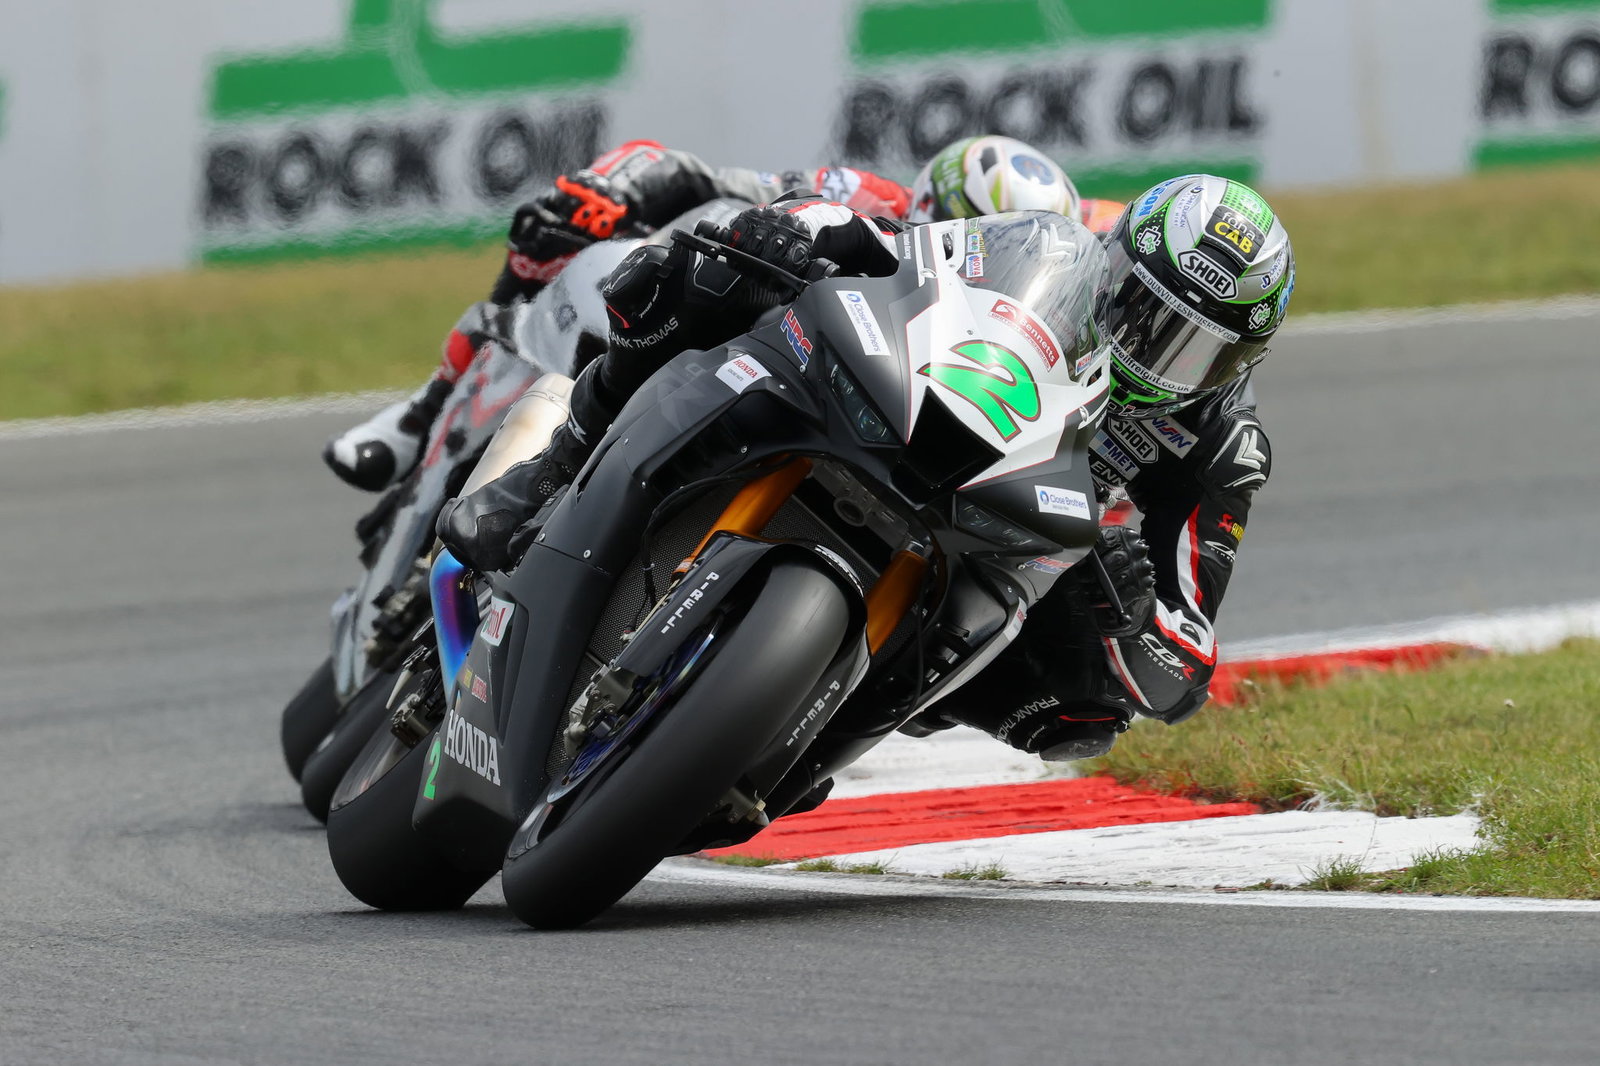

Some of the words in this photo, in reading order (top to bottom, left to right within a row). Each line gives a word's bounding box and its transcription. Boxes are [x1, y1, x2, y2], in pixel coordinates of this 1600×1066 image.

[1482, 34, 1600, 117] RO
[842, 62, 1093, 165] ROCK
[1117, 54, 1259, 147] OIL
[204, 118, 452, 230] ROCK
[1214, 222, 1253, 254] CAB
[973, 256, 981, 276] NOVA
[1184, 255, 1232, 295] SHOEI
[609, 331, 633, 348] ANK
[633, 317, 679, 348] THOMAS
[780, 308, 813, 366] HRC
[854, 304, 867, 323] Close
[863, 322, 881, 352] Brothers
[1020, 317, 1056, 362] Bennetts
[733, 360, 758, 378] HONDA
[917, 340, 1041, 443] 2
[1107, 447, 1136, 472] MET
[1113, 420, 1153, 459] SHOEI
[1091, 461, 1127, 486] ENN
[1050, 494, 1065, 505] Close
[1065, 496, 1087, 509] Brothers
[661, 571, 719, 634] PIRELLI
[1137, 640, 1184, 681] FIREBLADE
[1141, 632, 1195, 680] CBR
[786, 680, 840, 746] PIRELLI
[1013, 696, 1060, 722] FRANK
[423, 738, 441, 800] 2
[444, 709, 501, 786] HONDA
